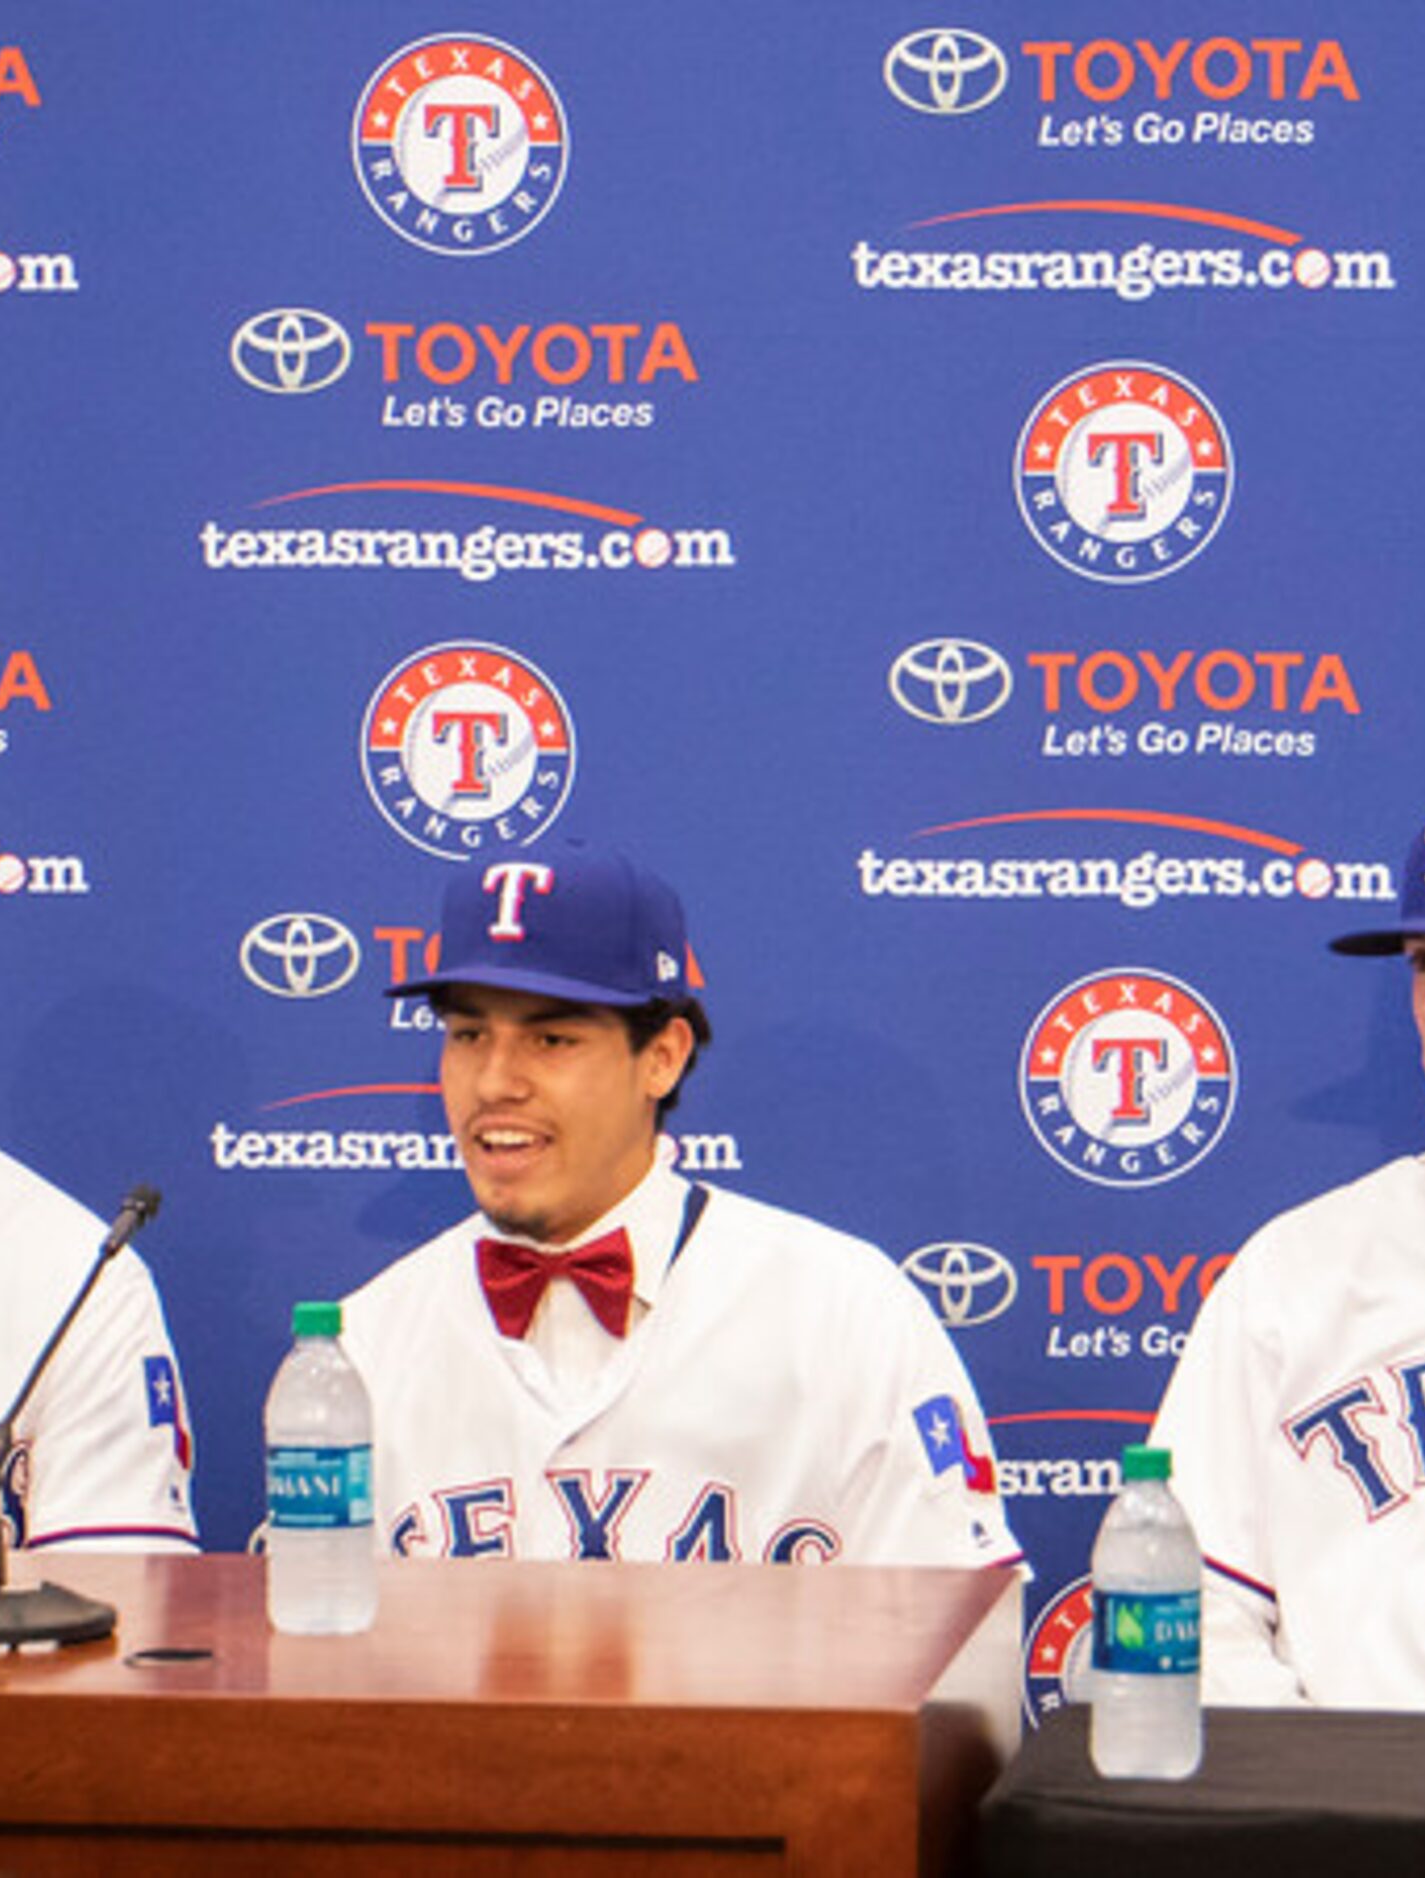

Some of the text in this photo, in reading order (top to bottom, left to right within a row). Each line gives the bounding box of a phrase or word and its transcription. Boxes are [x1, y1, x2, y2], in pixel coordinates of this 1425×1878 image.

[385, 48, 534, 100] TEXAS
[1022, 37, 1360, 102] TOYOTA
[424, 105, 500, 193] T
[1037, 110, 1315, 147] Let's Go Places
[370, 158, 552, 243] RANGERS
[849, 240, 1398, 302] texasrangers.com
[365, 322, 698, 385] TOYOTA
[381, 394, 655, 429] Let's Go Places
[1048, 376, 1198, 427] TEXAS
[1087, 433, 1163, 521] T
[198, 520, 738, 582] texasrangers.com
[1032, 488, 1217, 570] RANGERS
[394, 657, 541, 707] TEXAS
[1028, 649, 1361, 714] TOYOTA
[432, 712, 507, 800] T
[1041, 721, 1317, 757] Let's Go Places
[378, 764, 560, 848] RANGERS
[481, 862, 553, 942] T
[856, 848, 1399, 909] texasrangers.com
[1053, 983, 1201, 1033] TEXAS
[1092, 1039, 1167, 1126] T
[1037, 1093, 1220, 1174] RANGERS
[1046, 1325, 1132, 1358] Let's
